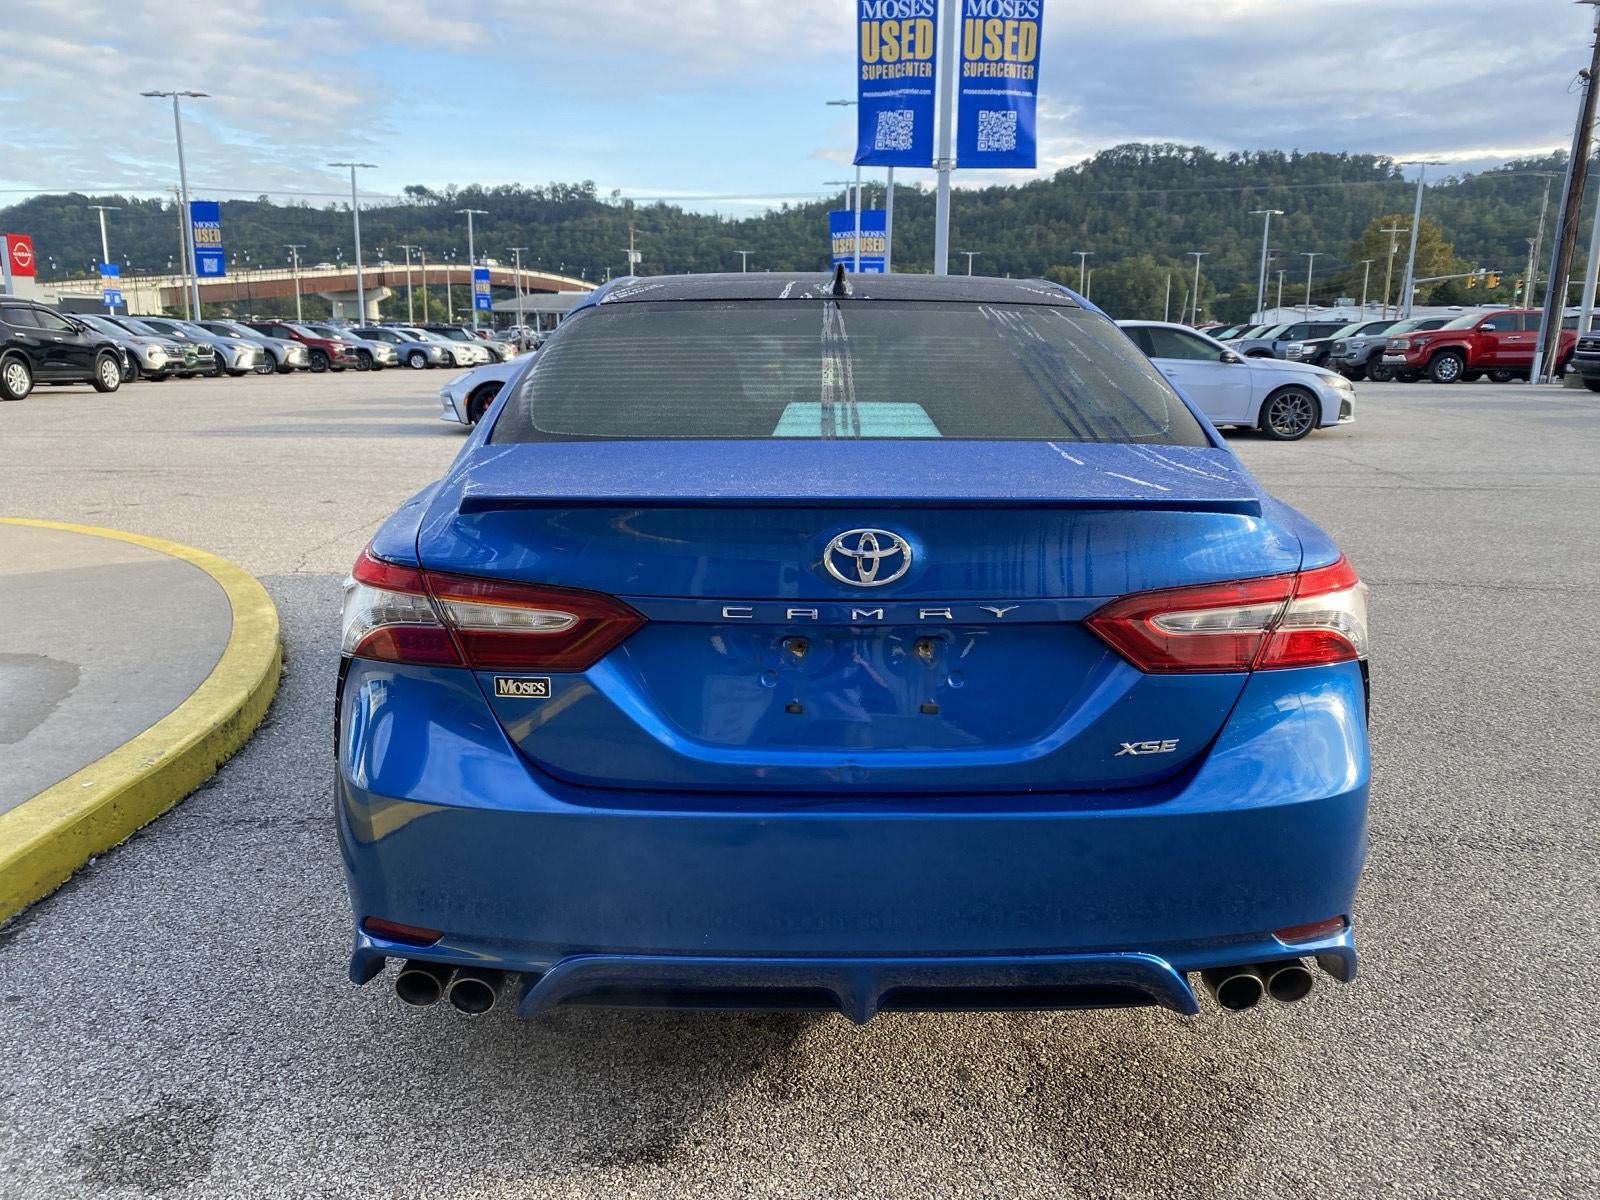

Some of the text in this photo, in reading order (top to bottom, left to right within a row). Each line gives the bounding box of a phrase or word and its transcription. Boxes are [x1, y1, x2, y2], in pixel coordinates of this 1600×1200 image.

[861, 0, 934, 19] MOSES
[966, 0, 1039, 19] MOSES
[861, 18, 934, 63] USED
[963, 18, 1038, 63] USED
[862, 62, 932, 81] SUPERCENTER
[963, 62, 1034, 80] SUPERCENTER
[194, 221, 220, 229] MOSES
[194, 228, 221, 243] USED
[832, 238, 854, 254] USED
[860, 238, 885, 252] USED
[722, 605, 1020, 620] CAMRY
[499, 679, 546, 695] MOSES
[1114, 739, 1180, 756] XSE
